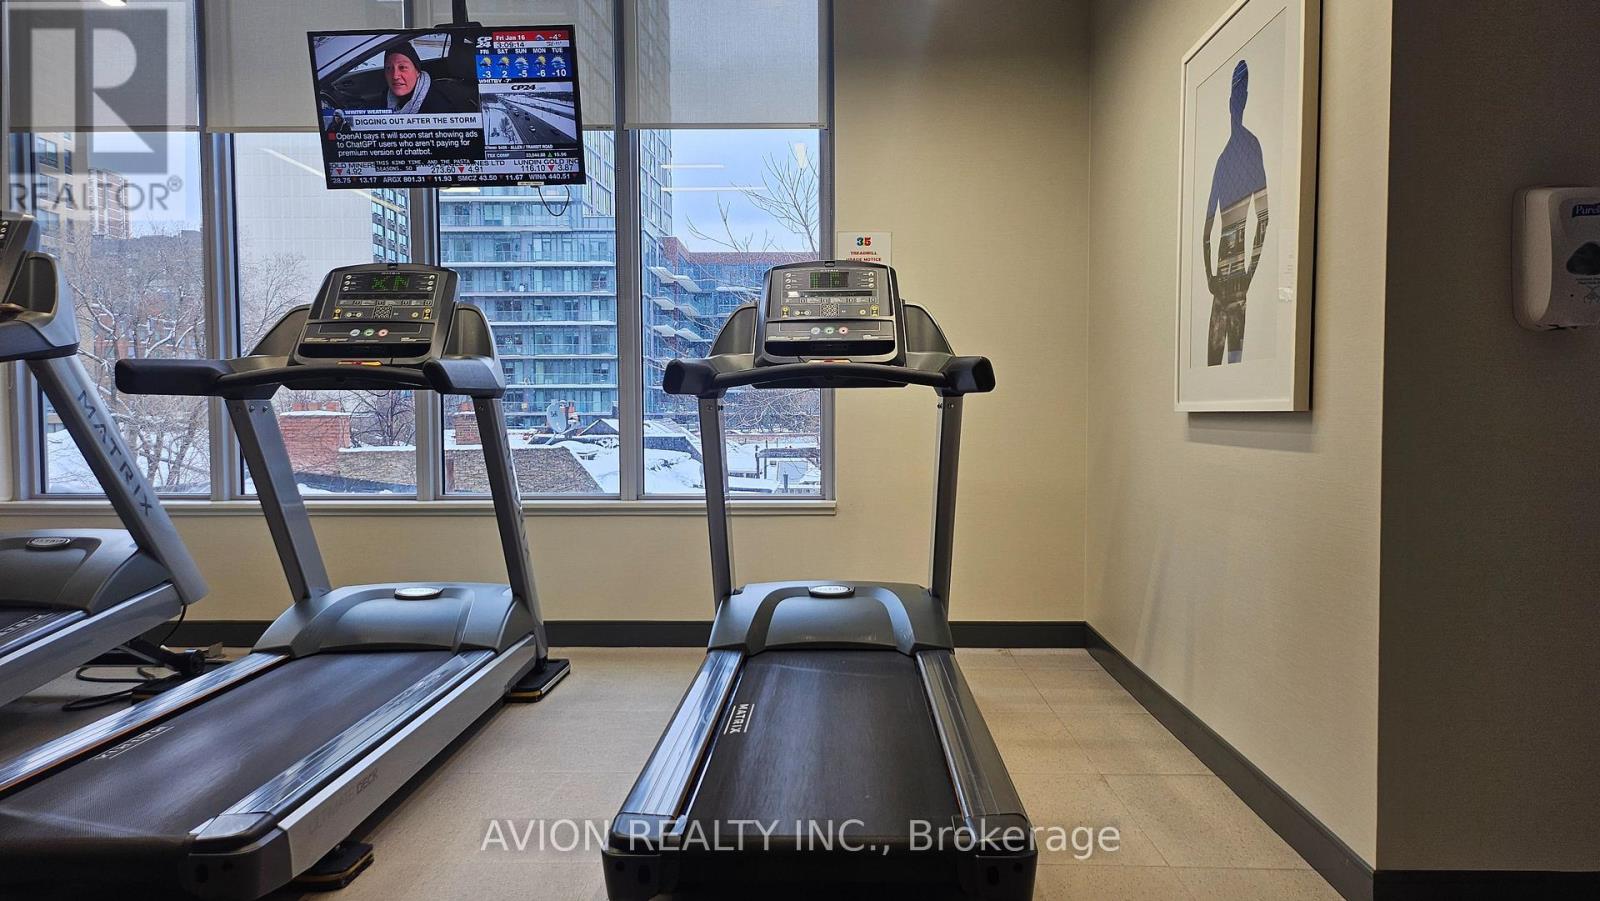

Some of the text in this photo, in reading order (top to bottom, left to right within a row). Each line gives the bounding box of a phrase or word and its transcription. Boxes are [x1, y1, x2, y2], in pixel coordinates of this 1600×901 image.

[336, 133, 362, 141] OpenAI
[435, 130, 464, 139] showing
[436, 140, 459, 148] paying
[404, 147, 432, 155] chatbot.
[856, 237, 872, 246] 35
[78, 390, 152, 516] MATRIX
[729, 703, 749, 734] MATRIX
